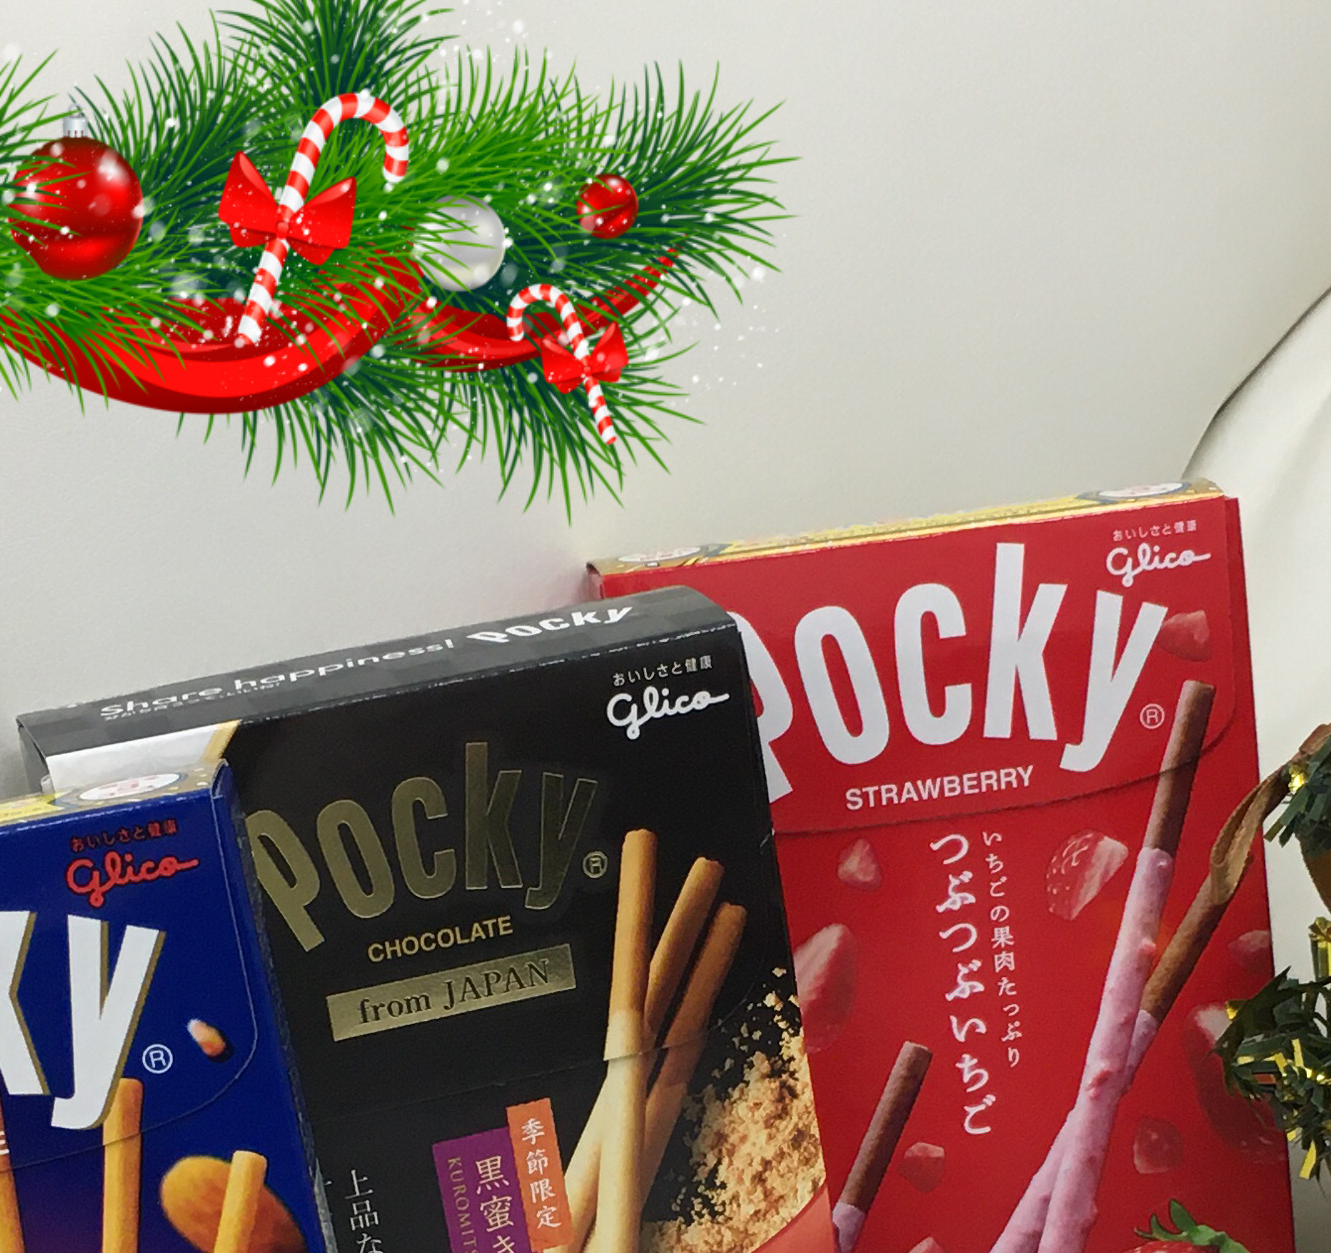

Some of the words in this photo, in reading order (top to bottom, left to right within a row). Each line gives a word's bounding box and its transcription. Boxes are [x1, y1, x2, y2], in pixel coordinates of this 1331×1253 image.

[1106, 542, 1211, 588] Glico
[234, 638, 454, 691] happiness!
[466, 606, 633, 643] Pocky
[607, 686, 730, 740] Glico
[845, 765, 1034, 810] STRAWBERRY
[67, 851, 199, 907] Glico
[245, 742, 598, 952] Pocky
[368, 916, 513, 963] CHOCOLATE
[982, 831, 1023, 1068] いちごの果肉たっぷり
[357, 990, 432, 1025] from
[444, 959, 551, 1011] JAPAN
[929, 833, 993, 1137] つぶつぶいちご
[521, 1118, 562, 1230] 季節限定
